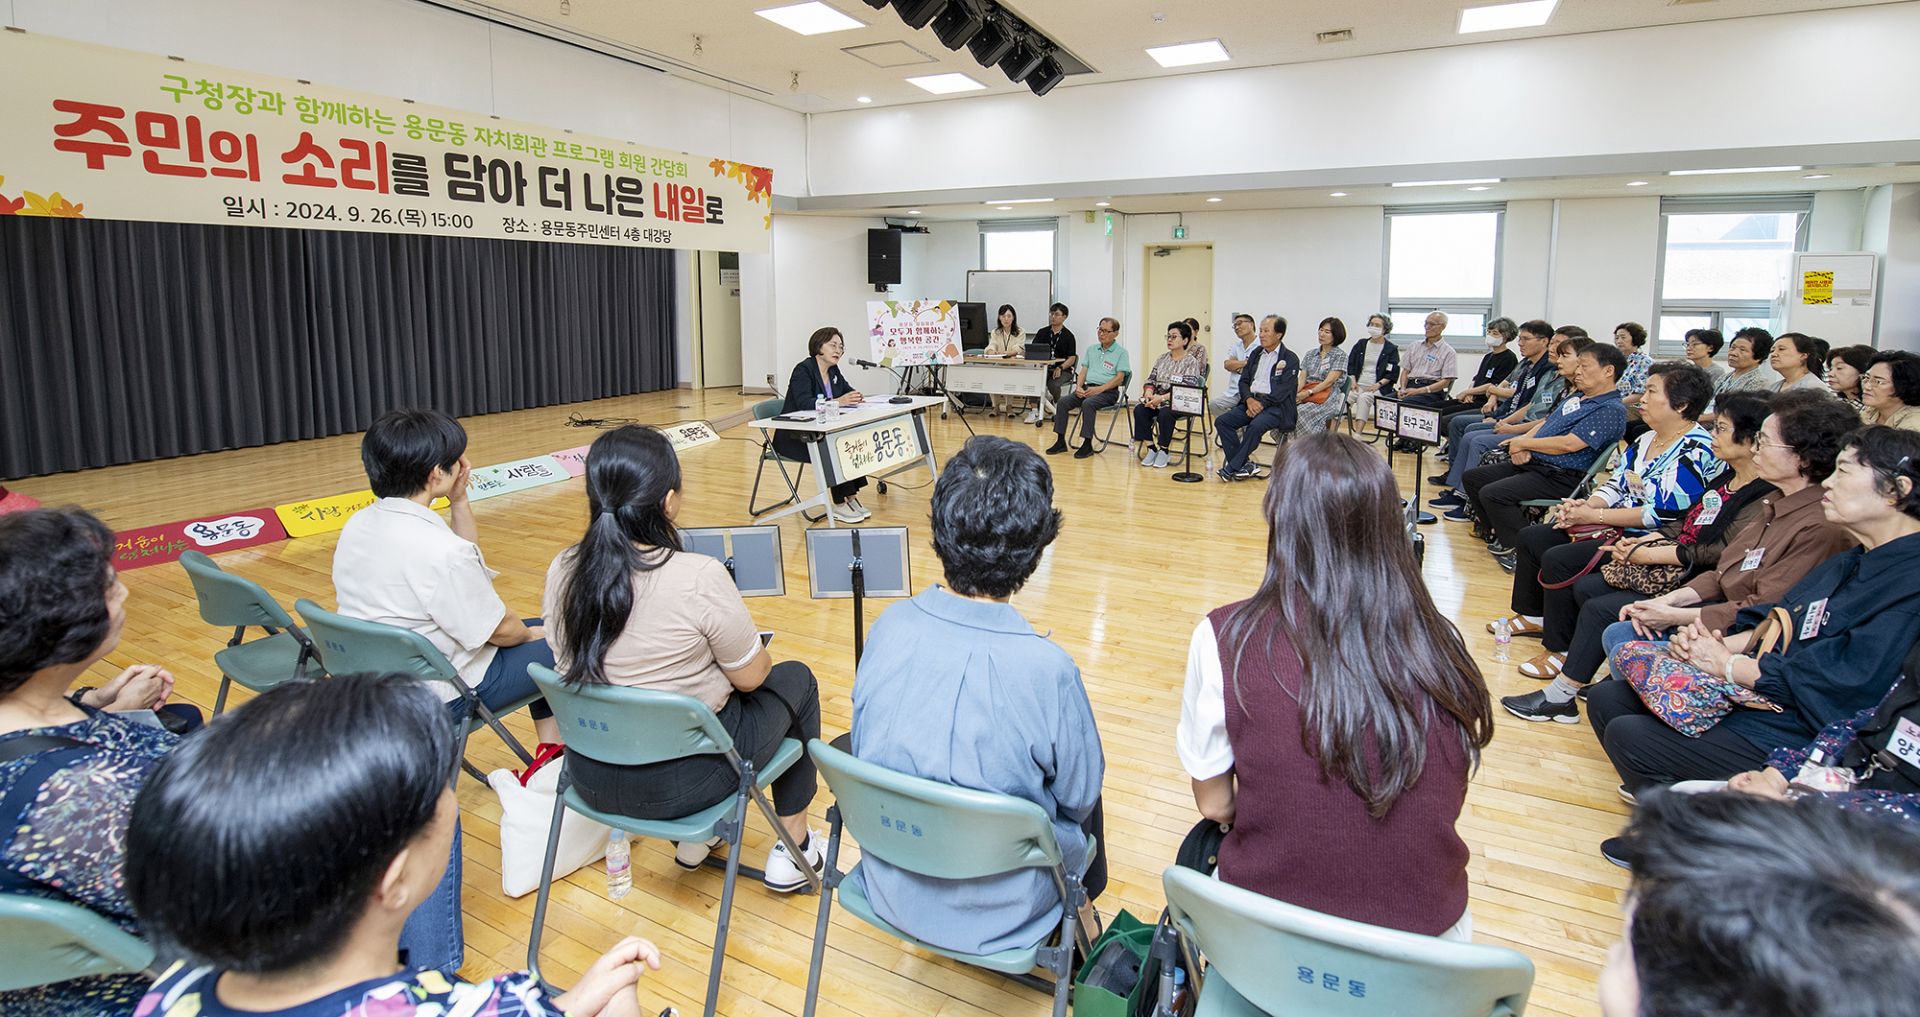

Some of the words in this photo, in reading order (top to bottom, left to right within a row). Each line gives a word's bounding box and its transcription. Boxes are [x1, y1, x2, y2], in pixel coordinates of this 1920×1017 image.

[160, 74, 286, 116] 구청장과
[294, 95, 395, 135] 함께하는
[403, 114, 467, 147] 용문동
[474, 127, 547, 159] 자치회관
[552, 140, 614, 169] 프로그램
[619, 151, 646, 174] 회원
[650, 158, 688, 179] 간담회
[52, 99, 261, 182] 주민의
[281, 131, 430, 198] 소리를
[444, 152, 528, 206] 담아
[538, 165, 572, 211] 더
[583, 172, 644, 218] 나은
[653, 182, 724, 225] 내일로
[223, 196, 266, 219] 일시
[274, 202, 279, 216] :
[287, 201, 342, 221] 2024.
[348, 206, 364, 223] 9.
[371, 208, 427, 228] 26.(목)
[432, 212, 474, 229] 15:00
[502, 217, 530, 234] 장소
[540, 219, 621, 241] 용문동주민센터
[623, 227, 641, 242] 4층
[643, 229, 672, 244] 대강당
[890, 327, 912, 336] 모두가
[1403, 415, 1417, 429] 탁구
[1418, 418, 1434, 432] 교실
[872, 427, 906, 462] 용문동
[506, 463, 553, 479] 사람들
[299, 505, 342, 521] 사랑
[115, 534, 165, 551] 거움이
[192, 520, 256, 541] 용문동
[1297, 965, 1367, 998] 용문동
